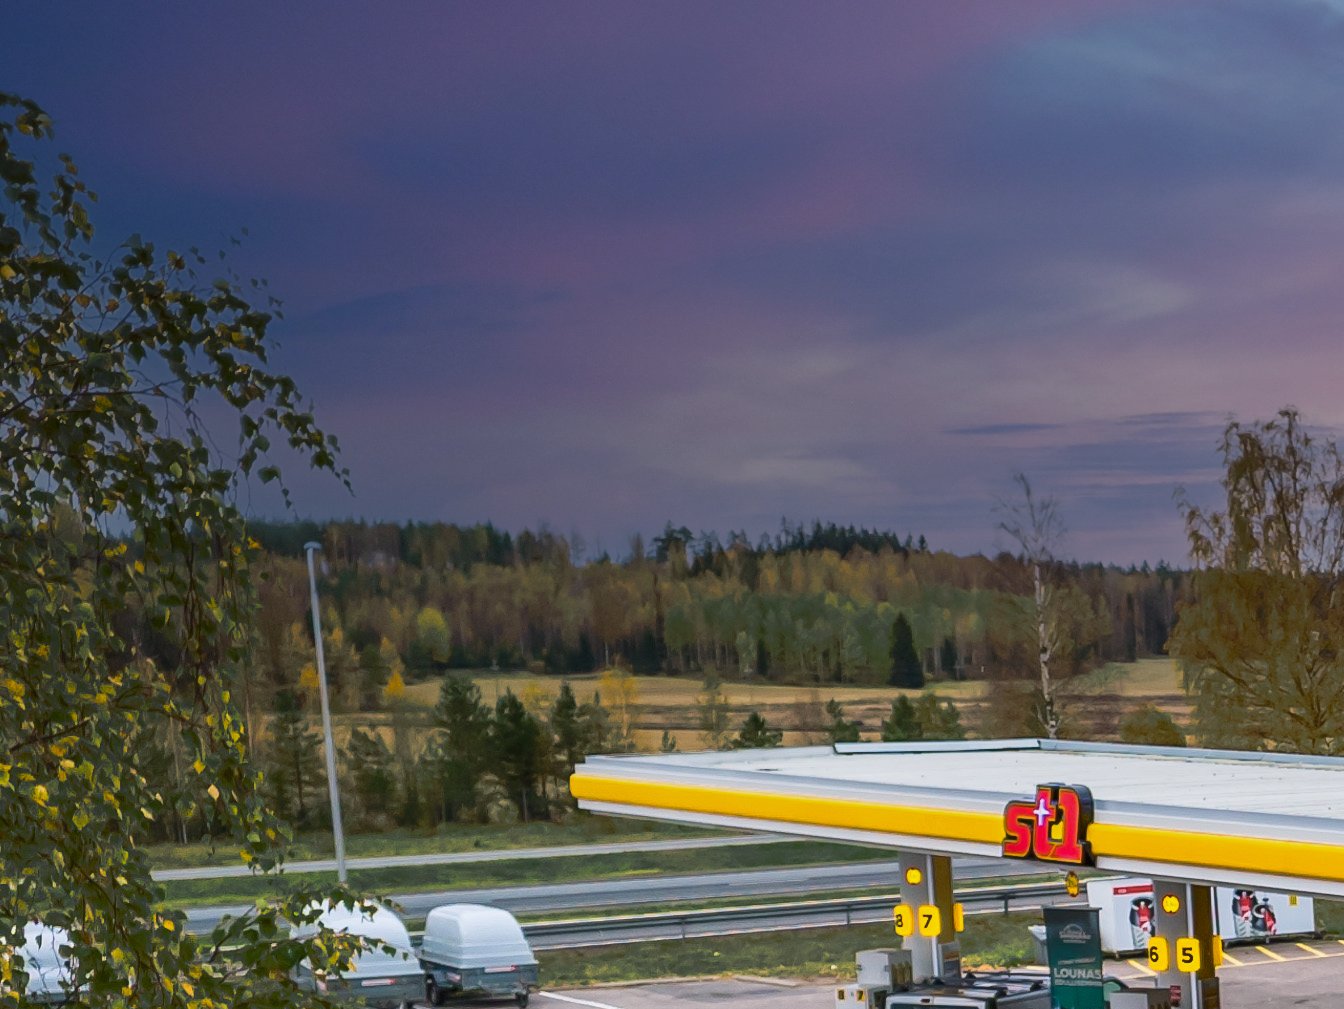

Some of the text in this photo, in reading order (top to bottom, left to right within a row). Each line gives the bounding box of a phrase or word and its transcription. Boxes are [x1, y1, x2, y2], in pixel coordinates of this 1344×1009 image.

[1002, 785, 1088, 865] st1
[923, 914, 934, 929] 7
[1149, 946, 1194, 964] 6 5
[1053, 967, 1102, 980] LOUNAS
